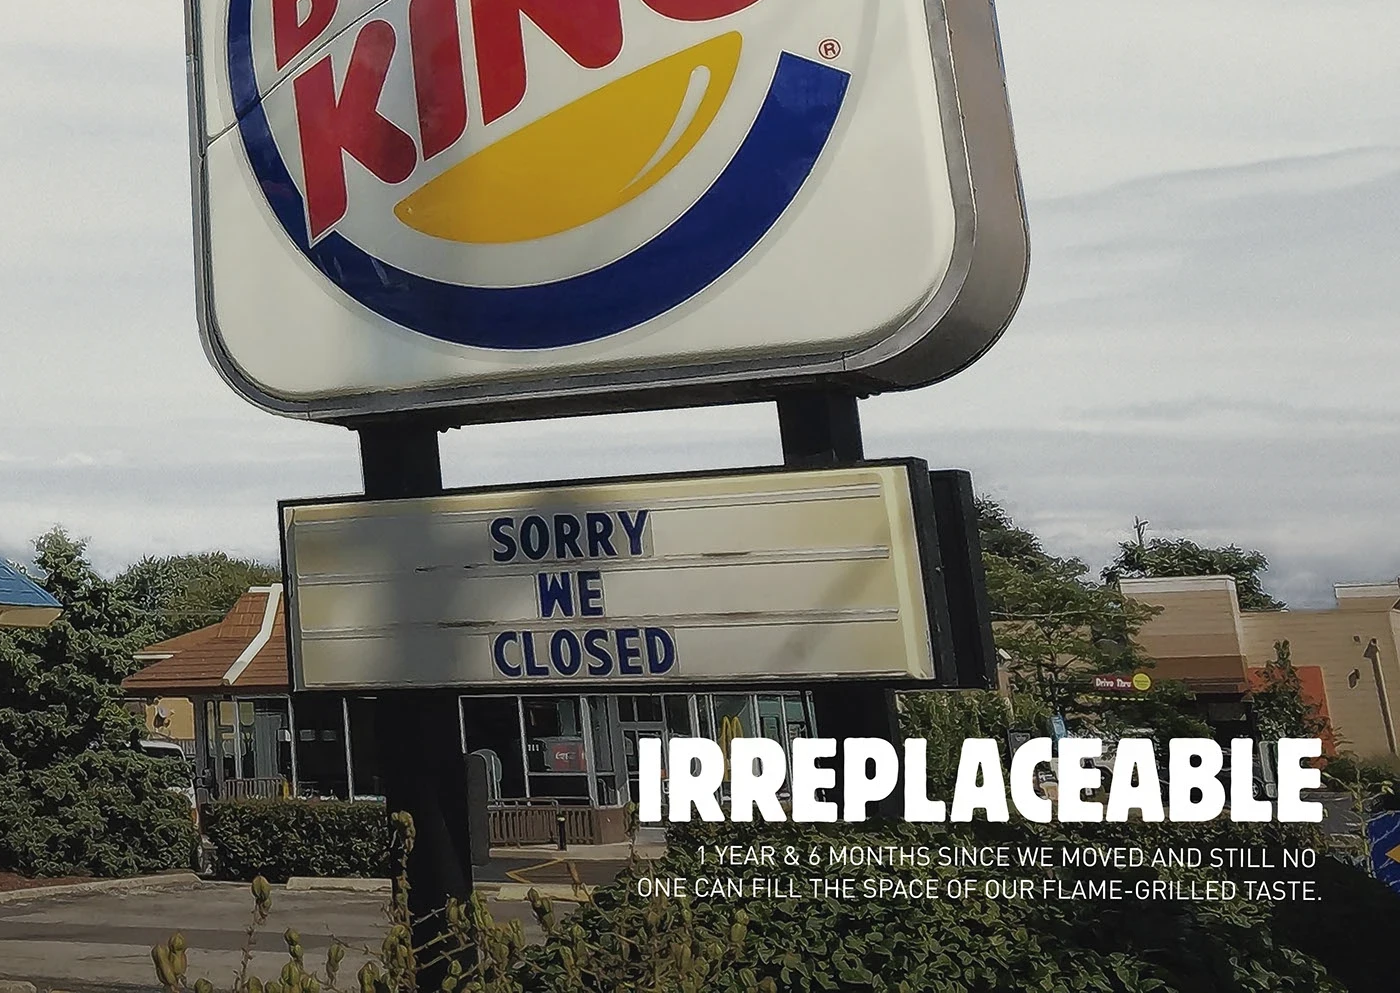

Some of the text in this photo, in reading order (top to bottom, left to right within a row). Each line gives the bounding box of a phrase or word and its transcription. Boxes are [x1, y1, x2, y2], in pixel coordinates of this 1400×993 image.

[490, 510, 650, 562] SORRY
[537, 571, 605, 618] WE
[493, 626, 676, 677] CLOSED
